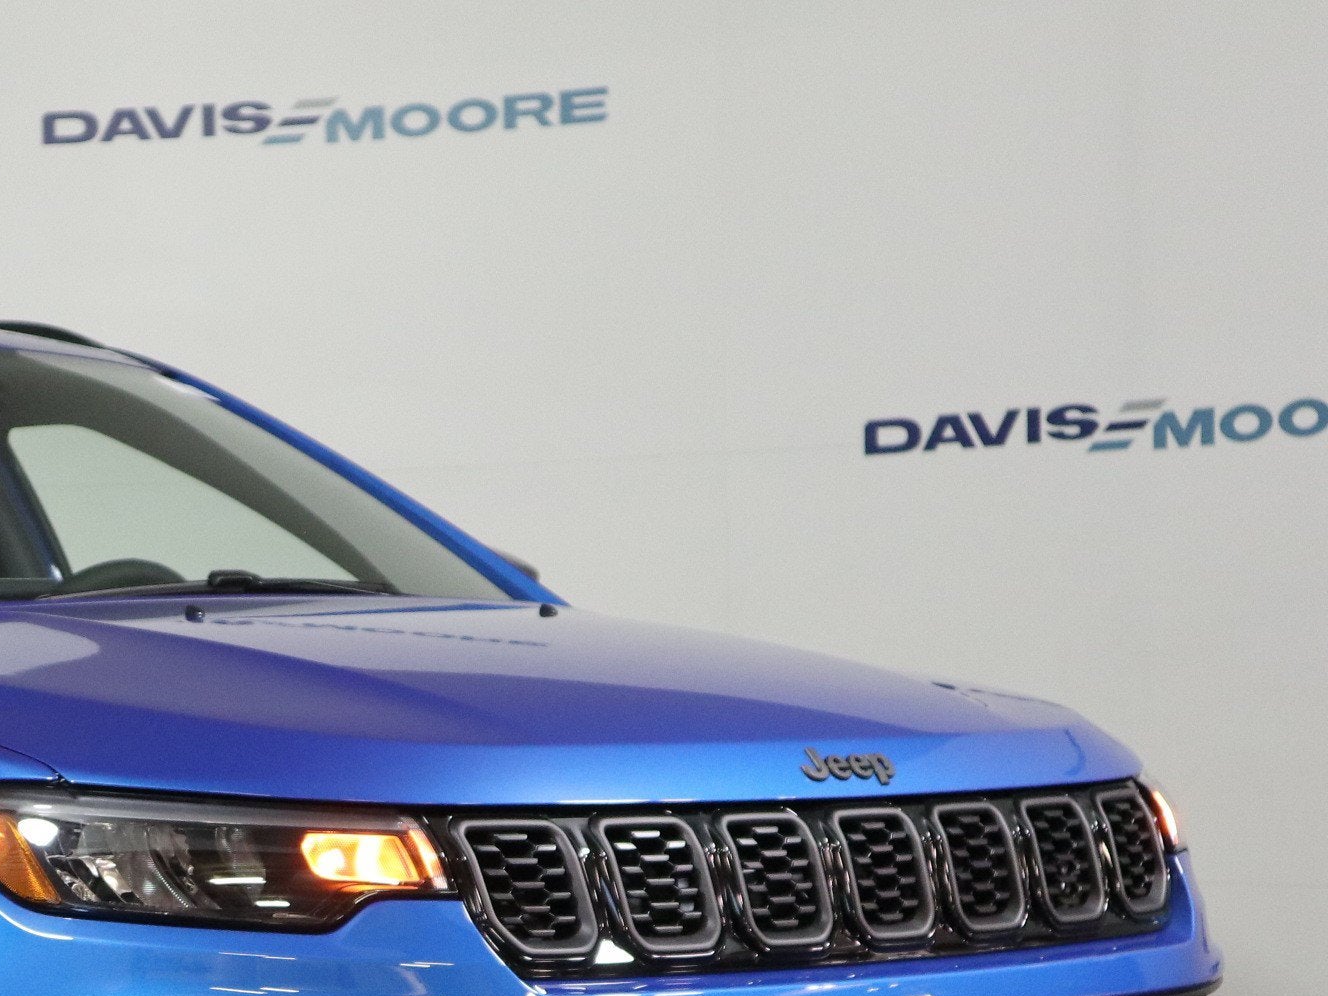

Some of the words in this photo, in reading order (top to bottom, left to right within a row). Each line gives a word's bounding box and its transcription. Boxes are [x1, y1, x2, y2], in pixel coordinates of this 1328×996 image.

[41, 101, 273, 144] DAVIS
[325, 86, 609, 143] MOORE
[864, 404, 1099, 455] DAVIS
[800, 747, 896, 786] Jeep
